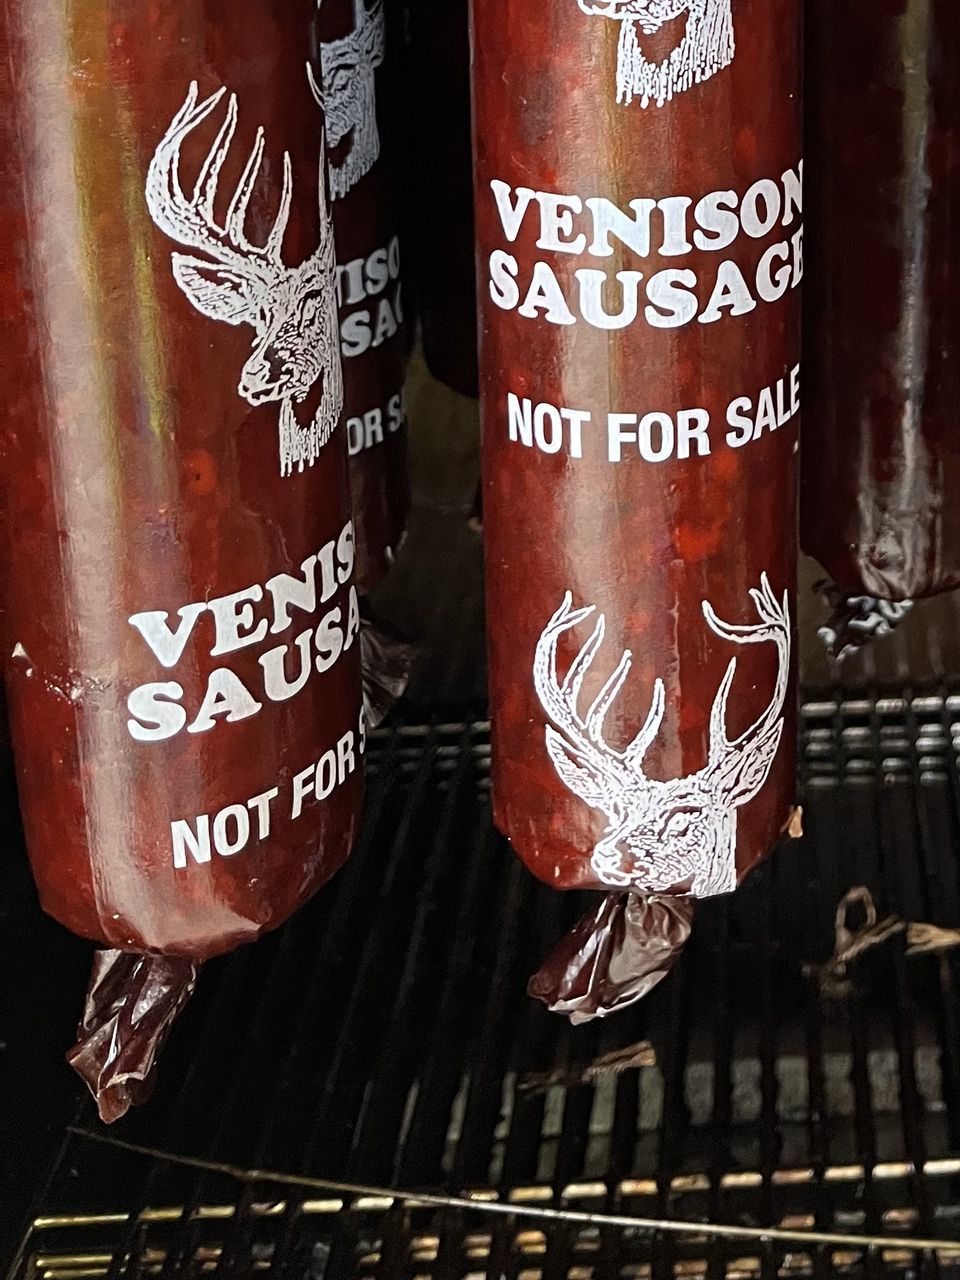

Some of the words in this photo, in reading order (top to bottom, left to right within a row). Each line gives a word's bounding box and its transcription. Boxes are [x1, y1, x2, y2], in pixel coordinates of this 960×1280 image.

[490, 158, 803, 258] VENISON
[489, 223, 804, 330] SAUSAGE
[507, 391, 591, 459] NOT
[607, 407, 711, 463] FOR
[726, 363, 799, 448] SALE
[128, 519, 355, 668] VENIS
[127, 584, 360, 741] SAUSA
[172, 786, 278, 870] NOT
[291, 729, 356, 818] FOR
